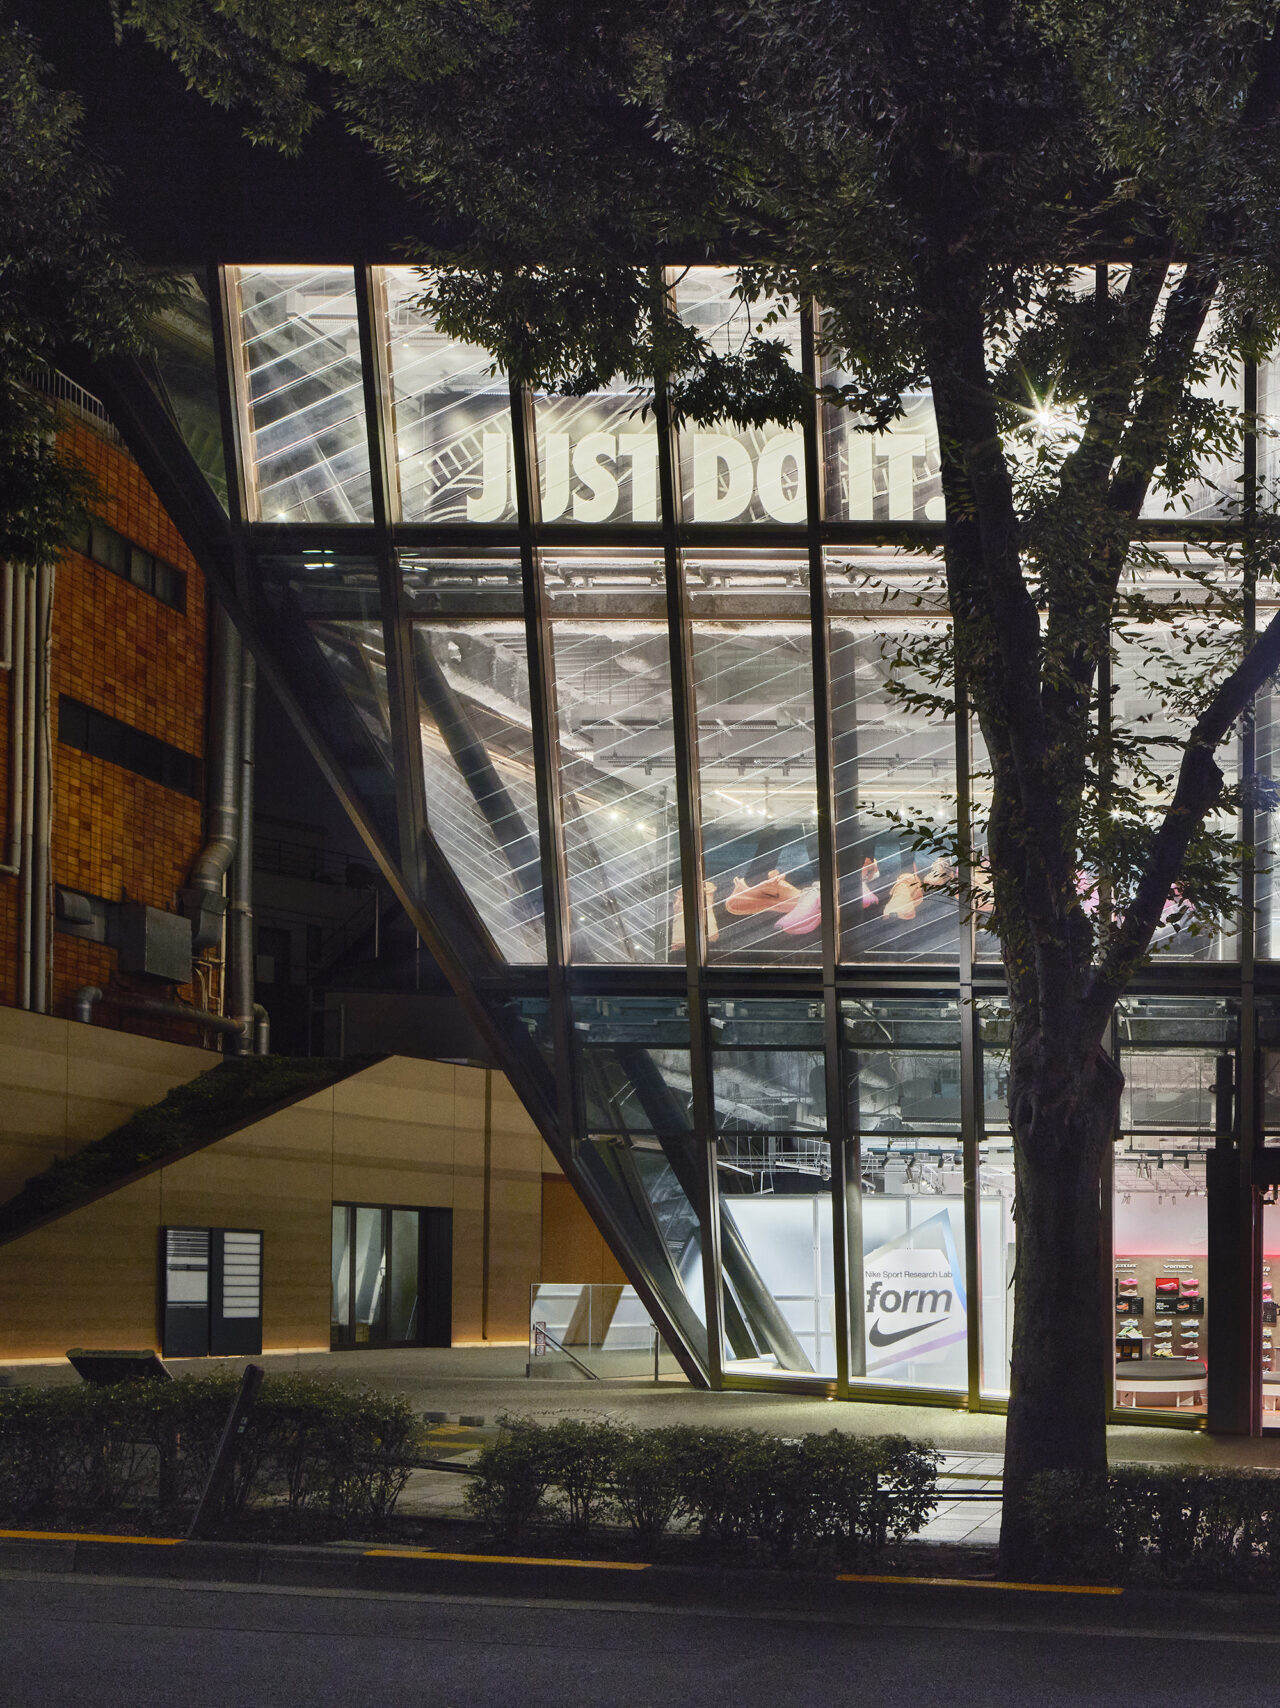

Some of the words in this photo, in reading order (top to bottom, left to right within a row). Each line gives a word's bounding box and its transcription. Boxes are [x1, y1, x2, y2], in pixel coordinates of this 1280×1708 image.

[466, 433, 660, 523] JUST
[693, 433, 807, 524] DO
[848, 433, 946, 521] IT.
[865, 1271, 881, 1279] Nike
[883, 1271, 902, 1280] Sport
[904, 1271, 938, 1279] Research
[866, 1282, 952, 1313] form
